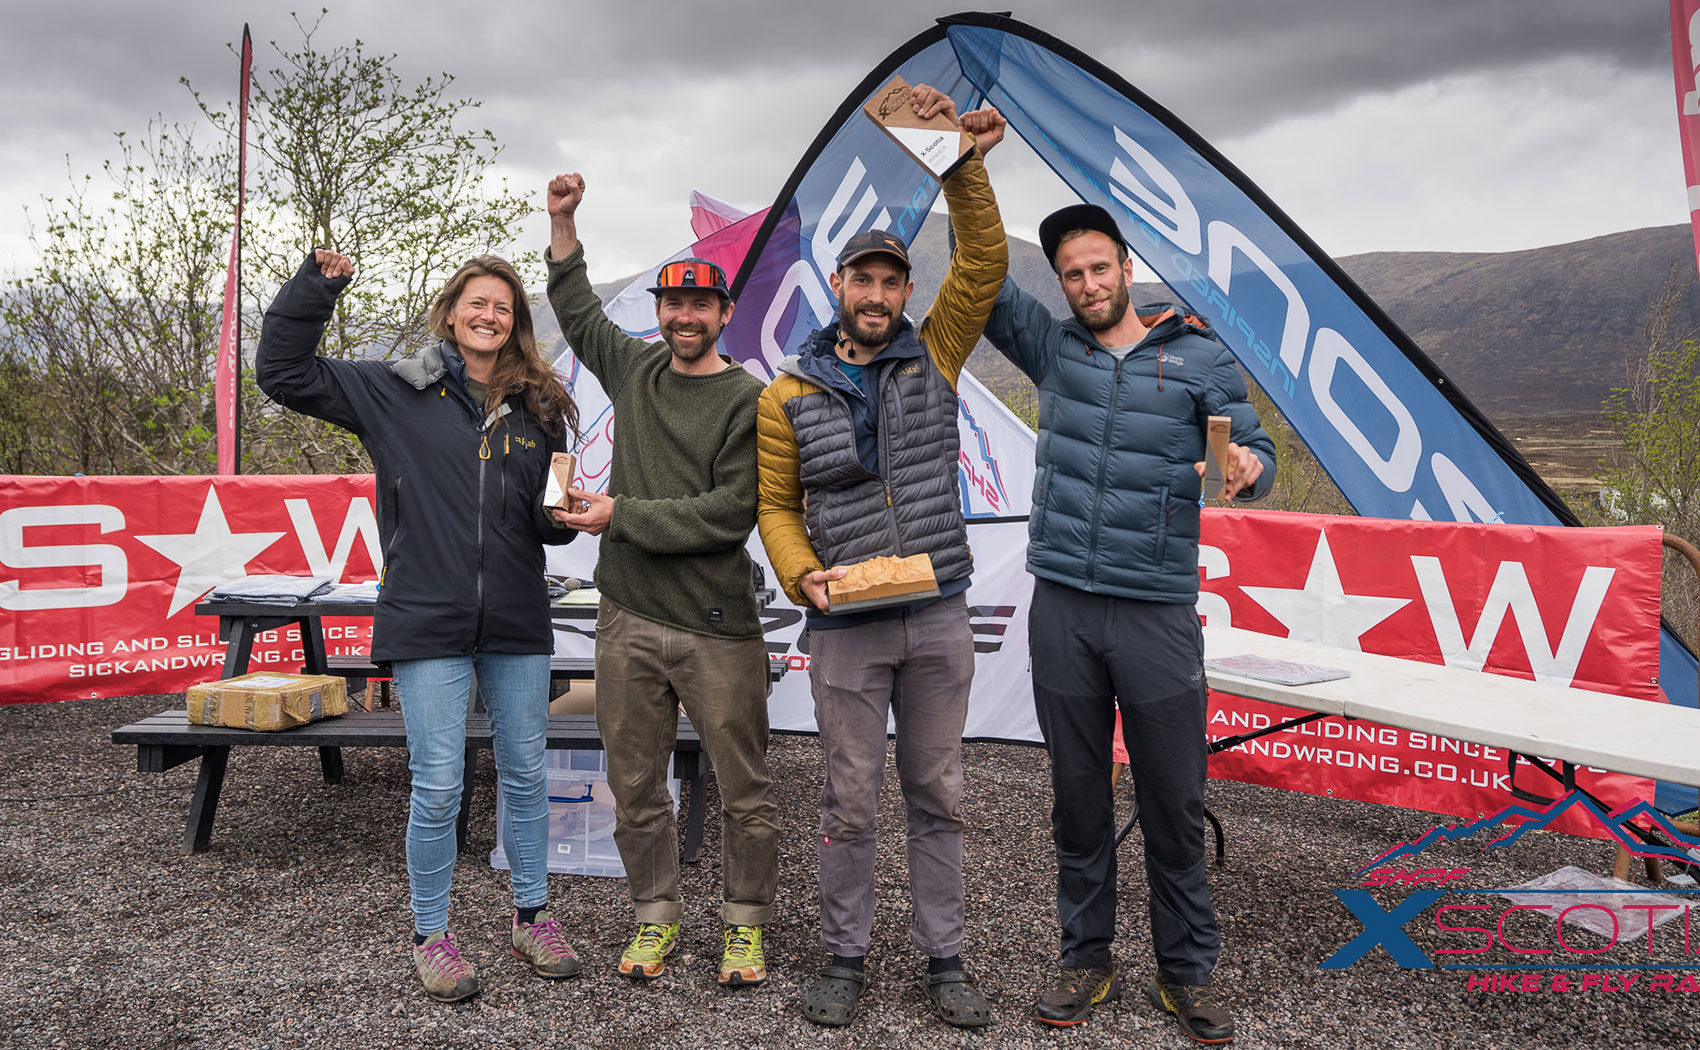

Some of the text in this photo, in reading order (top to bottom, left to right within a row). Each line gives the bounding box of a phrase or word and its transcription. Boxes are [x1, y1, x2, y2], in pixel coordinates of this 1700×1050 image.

[112, 637, 169, 654] AND
[1210, 709, 1271, 730] AND
[1281, 716, 1398, 747] SLIDING
